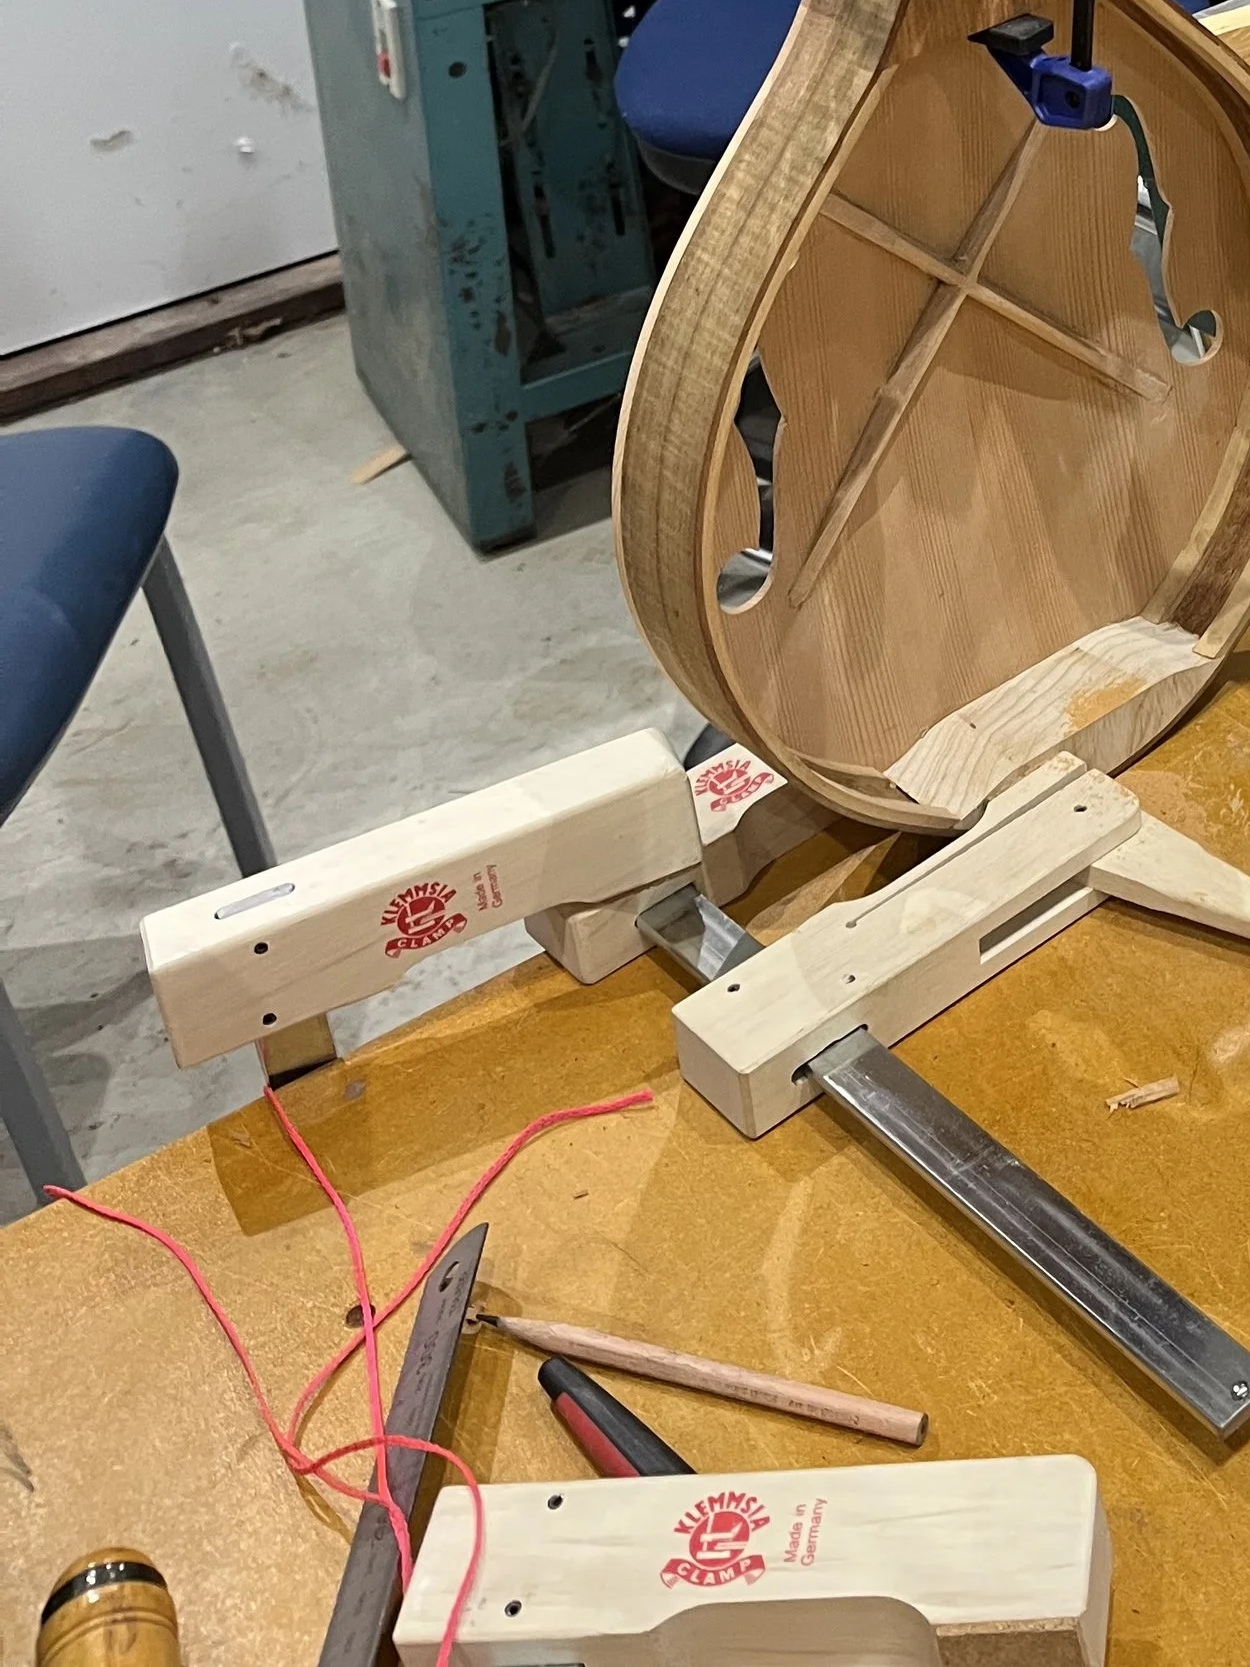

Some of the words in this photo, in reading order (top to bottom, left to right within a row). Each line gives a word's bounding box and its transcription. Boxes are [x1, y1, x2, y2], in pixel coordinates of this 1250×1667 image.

[380, 882, 457, 927] KLEMMSIA
[486, 864, 503, 908] Germany
[397, 918, 454, 948] CLAMP
[674, 1491, 770, 1534] KLEMMSIA
[783, 1521, 803, 1563] Made
[796, 1503, 807, 1517] in
[801, 1498, 828, 1566] Germany
[677, 1559, 752, 1586] CLAMP
